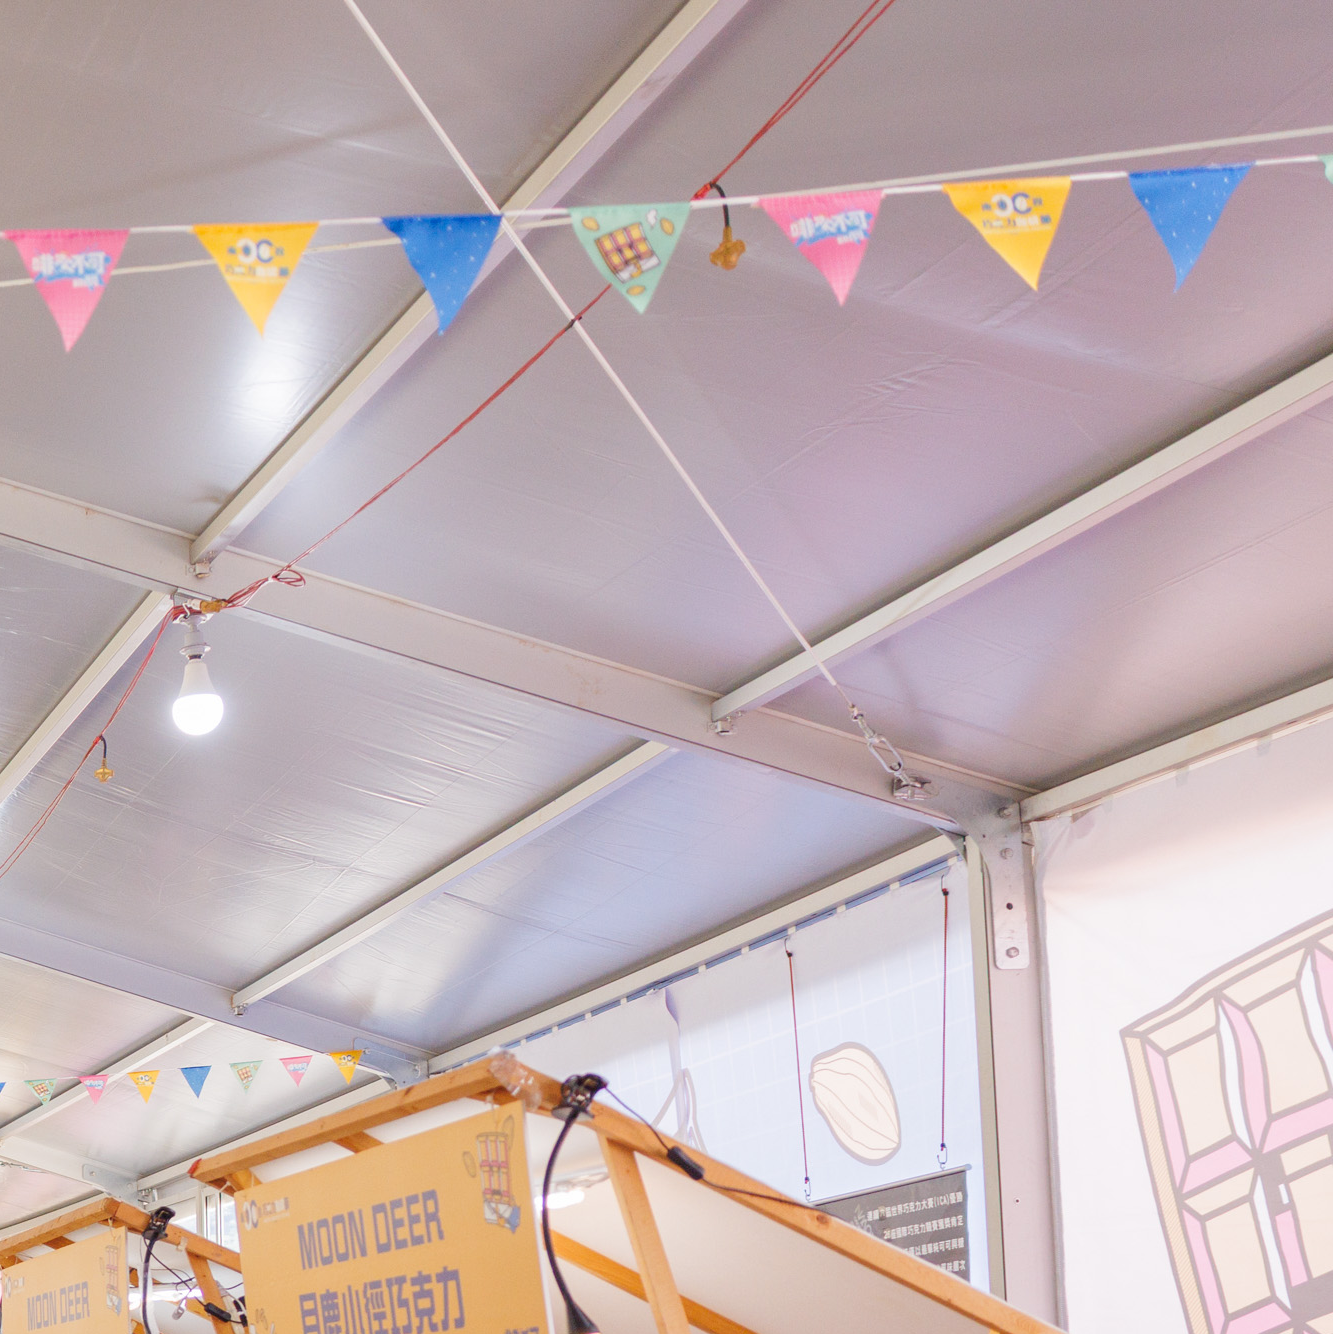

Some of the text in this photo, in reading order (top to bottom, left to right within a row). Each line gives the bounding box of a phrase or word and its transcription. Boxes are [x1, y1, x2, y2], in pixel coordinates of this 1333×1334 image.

[297, 1208, 367, 1270] MOON
[371, 1190, 444, 1254] DEER
[27, 1290, 57, 1331] MOON
[59, 1281, 90, 1323] DEER
